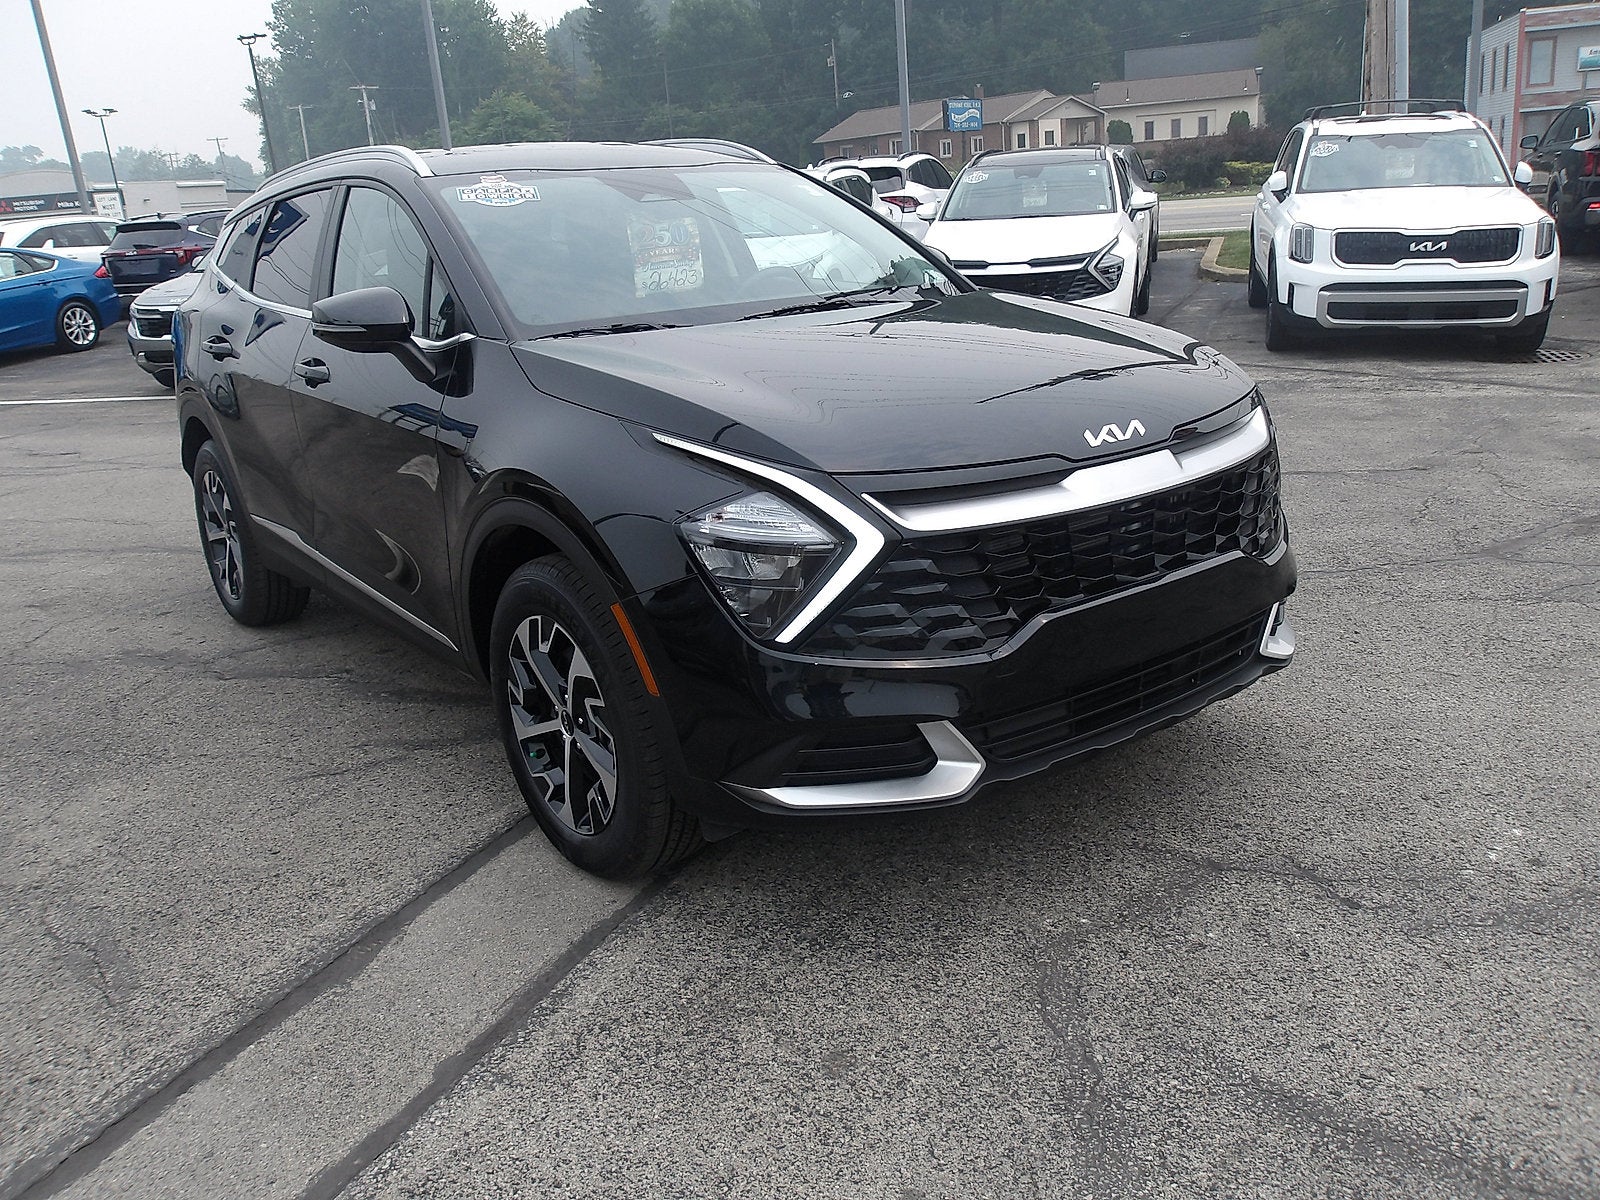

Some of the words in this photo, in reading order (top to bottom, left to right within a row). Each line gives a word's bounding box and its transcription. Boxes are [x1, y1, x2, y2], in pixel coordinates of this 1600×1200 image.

[12, 199, 46, 207] MITSUBISHI
[57, 201, 74, 209] Mike
[638, 222, 691, 249] 250
[1409, 240, 1448, 252] KIA
[1082, 418, 1147, 448] KIA
